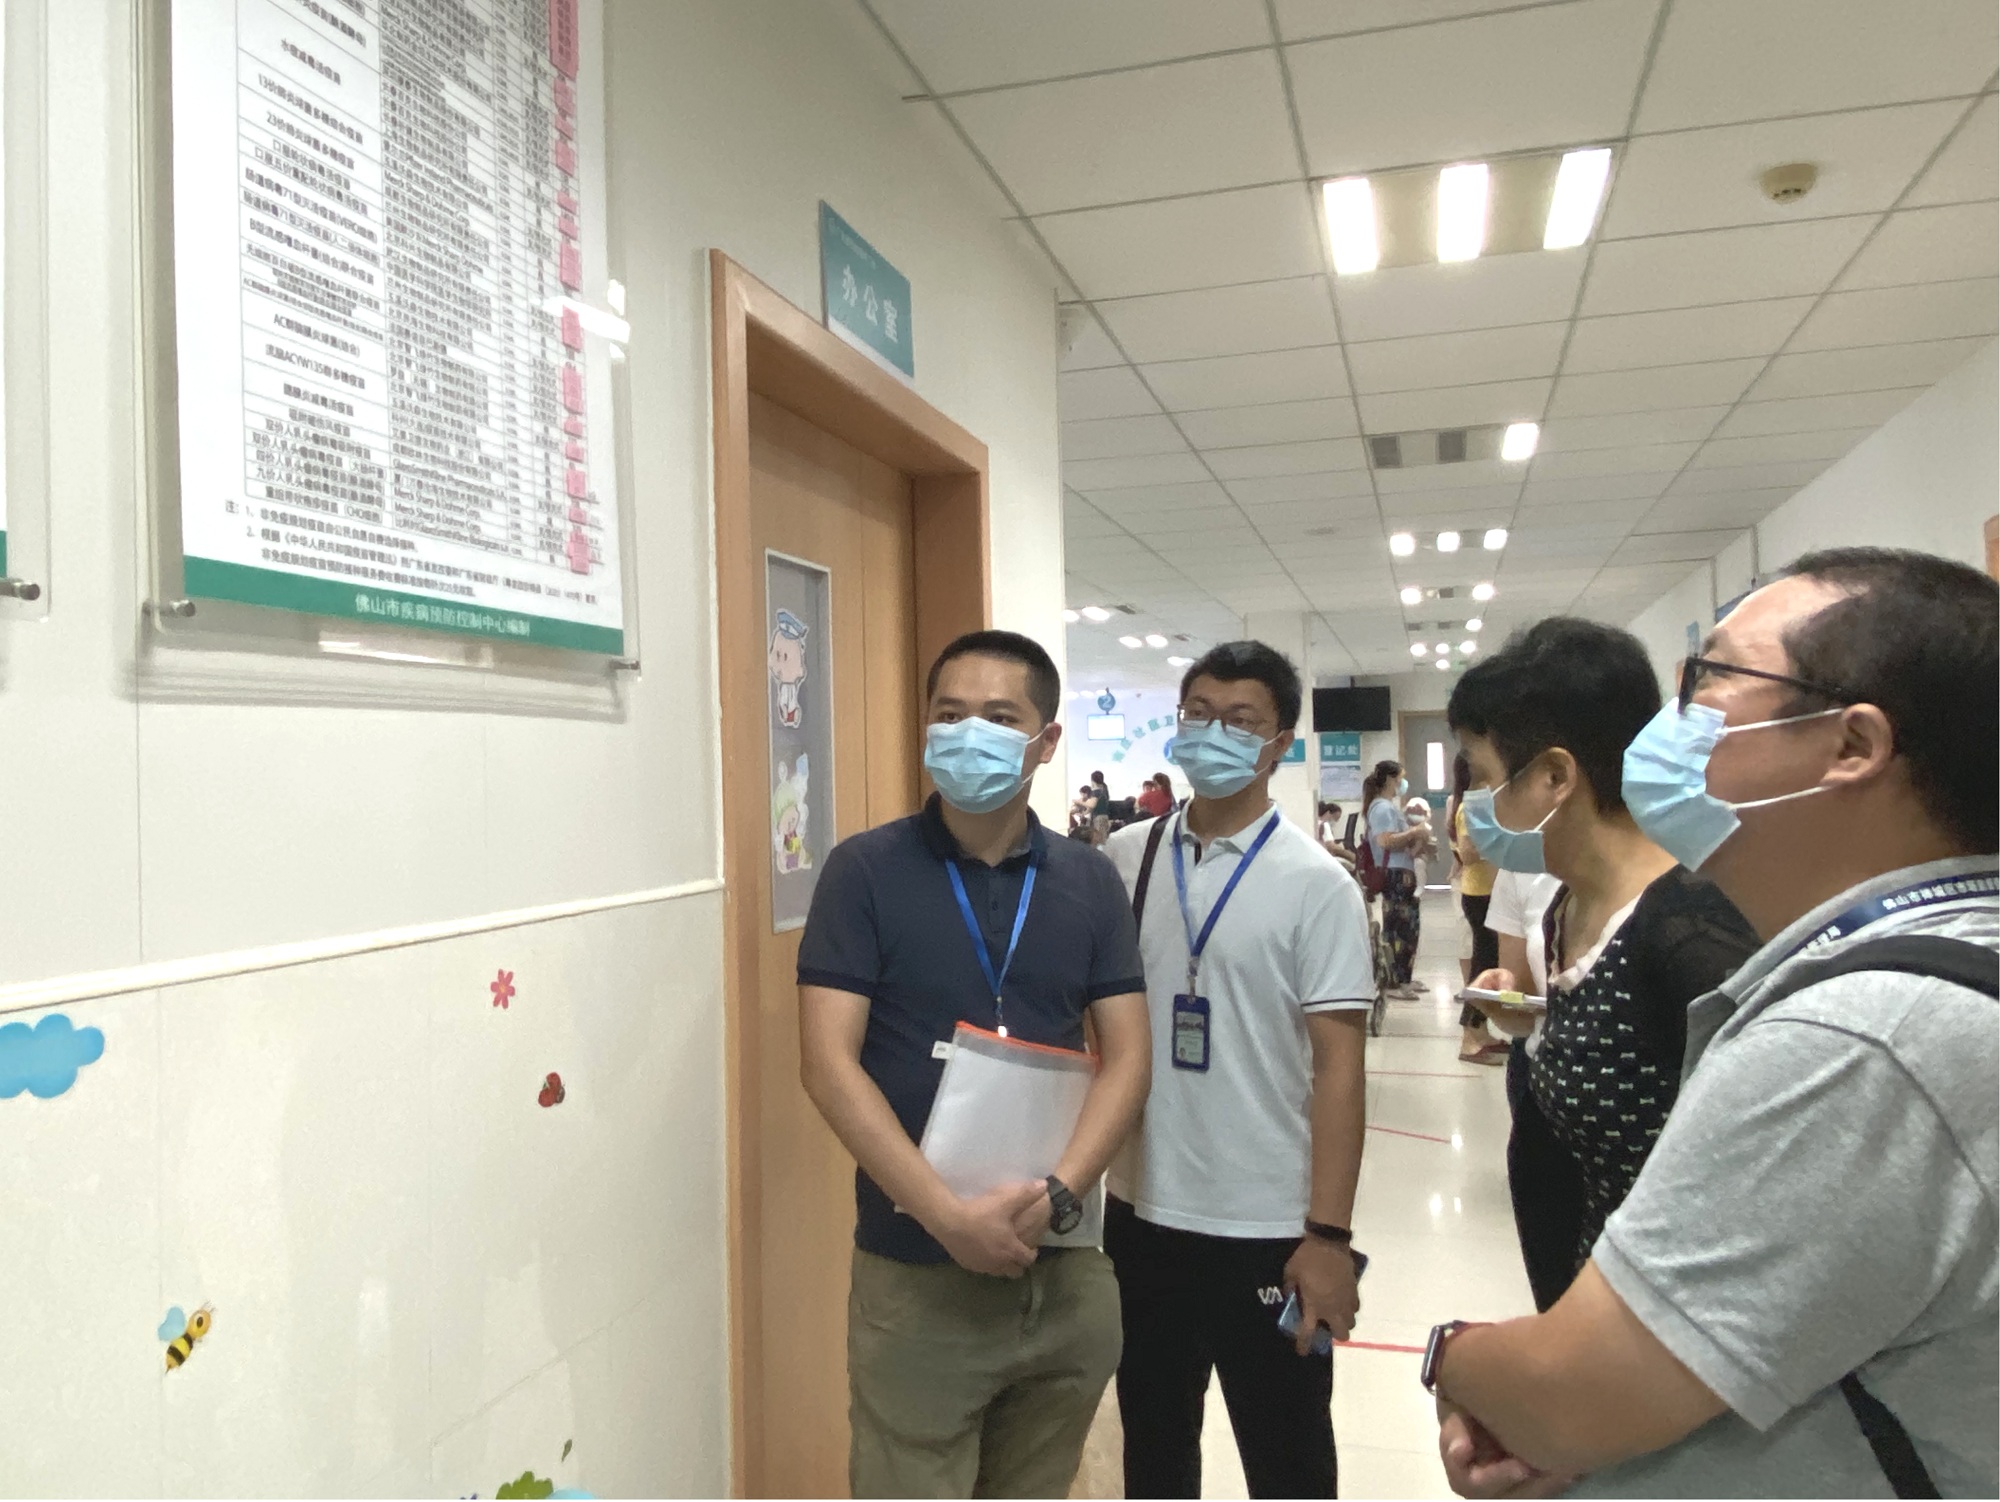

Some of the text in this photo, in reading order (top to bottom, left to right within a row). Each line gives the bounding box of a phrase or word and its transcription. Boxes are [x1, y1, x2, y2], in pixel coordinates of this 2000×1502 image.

[841, 263, 899, 344] 办公室
[355, 592, 531, 637] 佛山市疾病预防控制中心编制
